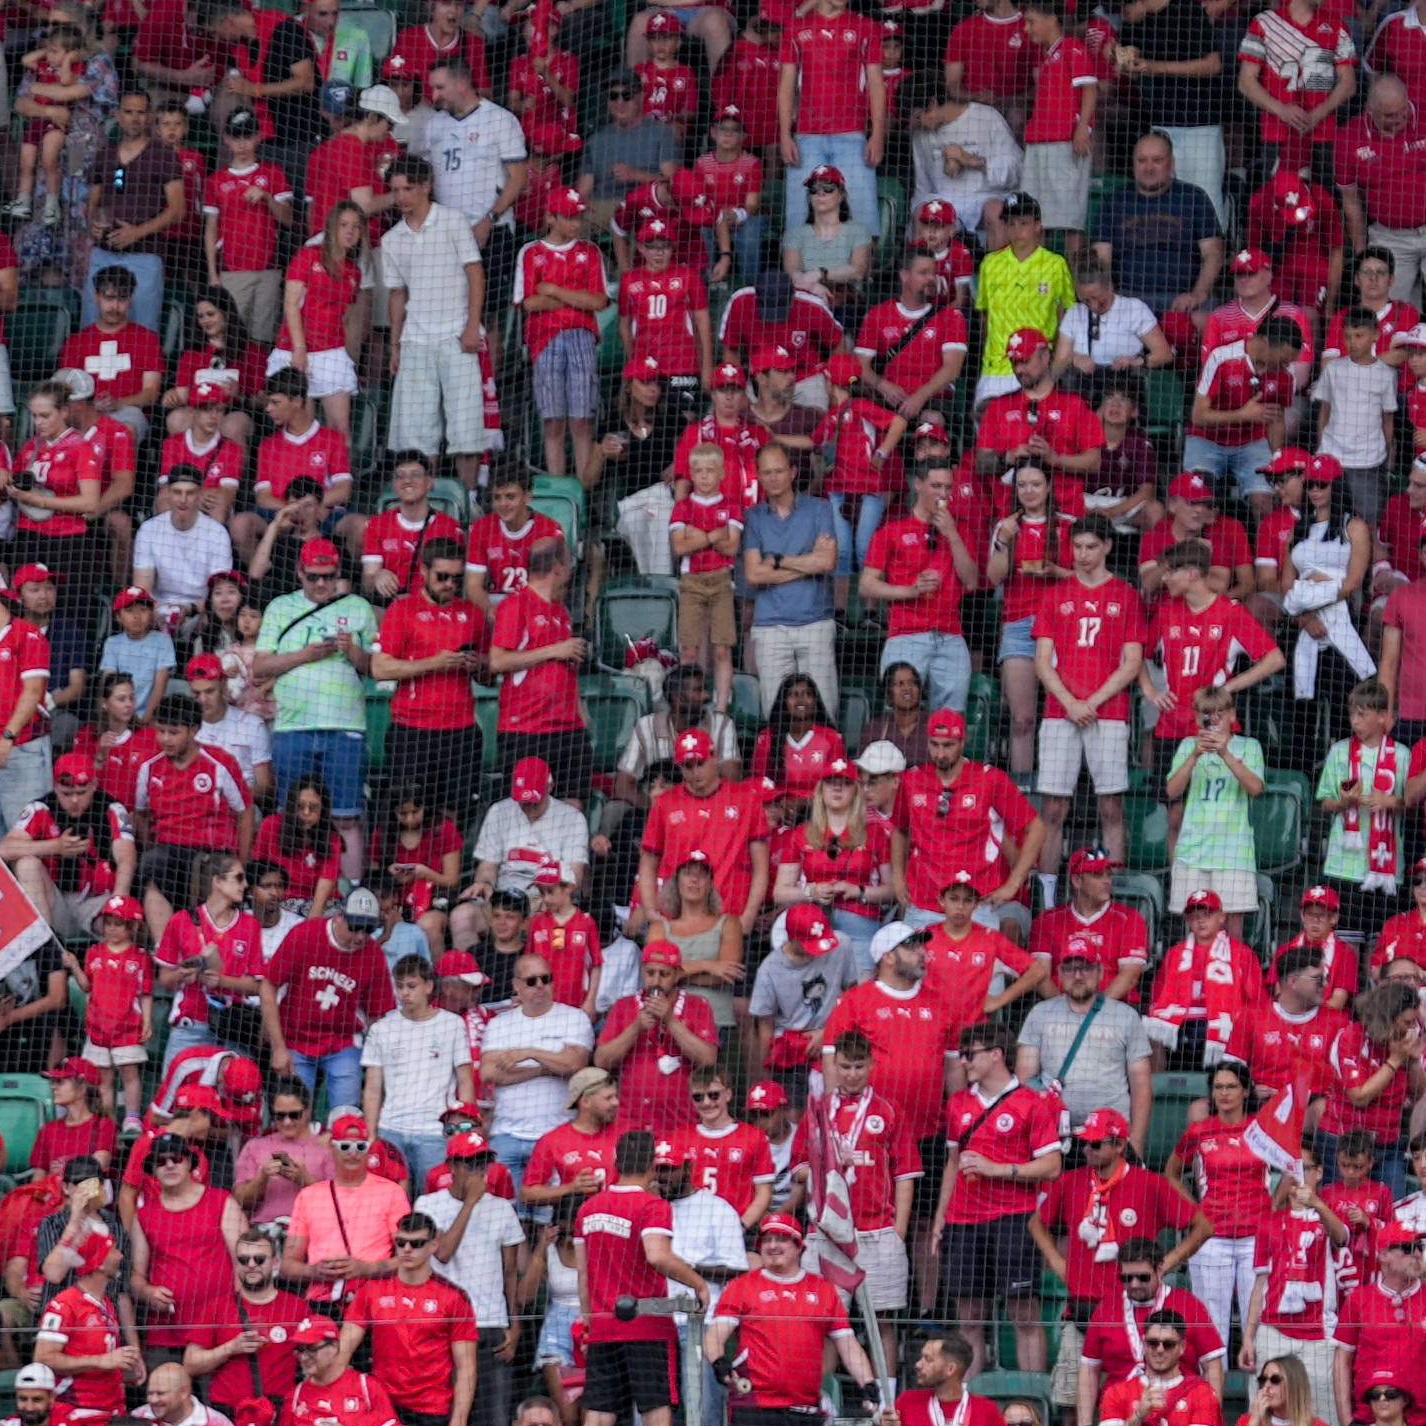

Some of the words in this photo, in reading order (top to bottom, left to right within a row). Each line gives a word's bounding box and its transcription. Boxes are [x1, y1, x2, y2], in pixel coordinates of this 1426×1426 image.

[647, 294, 667, 320] 10
[1076, 618, 1101, 647] 17
[1183, 646, 1200, 678] 11
[703, 1166, 719, 1196] 5
